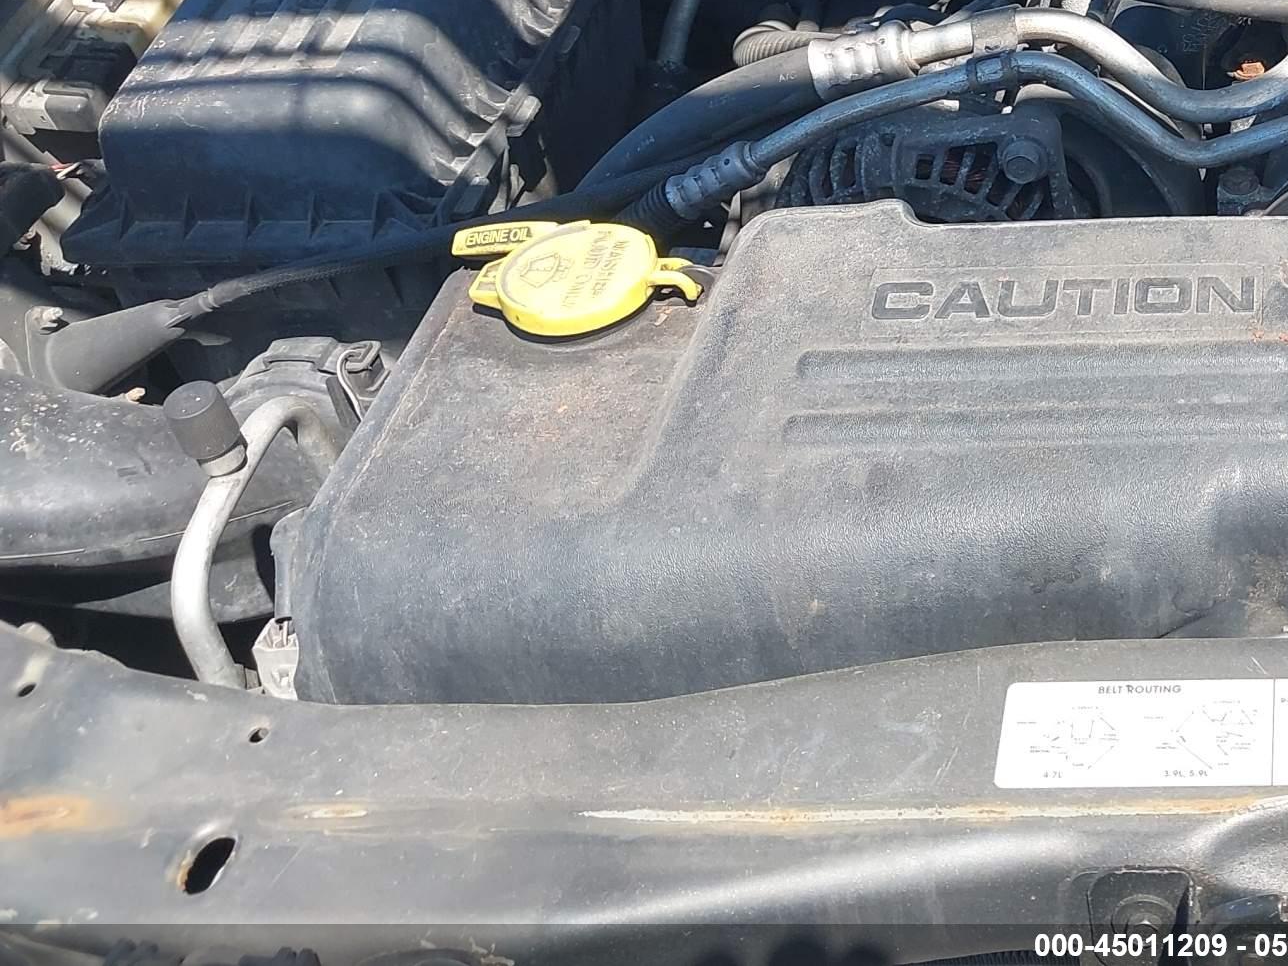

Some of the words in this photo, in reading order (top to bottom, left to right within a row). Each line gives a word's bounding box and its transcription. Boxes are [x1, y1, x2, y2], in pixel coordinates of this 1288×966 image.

[465, 228, 509, 248] ENGINE
[509, 226, 532, 242] OIL
[870, 276, 1256, 320] CAUTION
[1098, 685, 1123, 695] BELT
[1125, 684, 1182, 694] ROUTING
